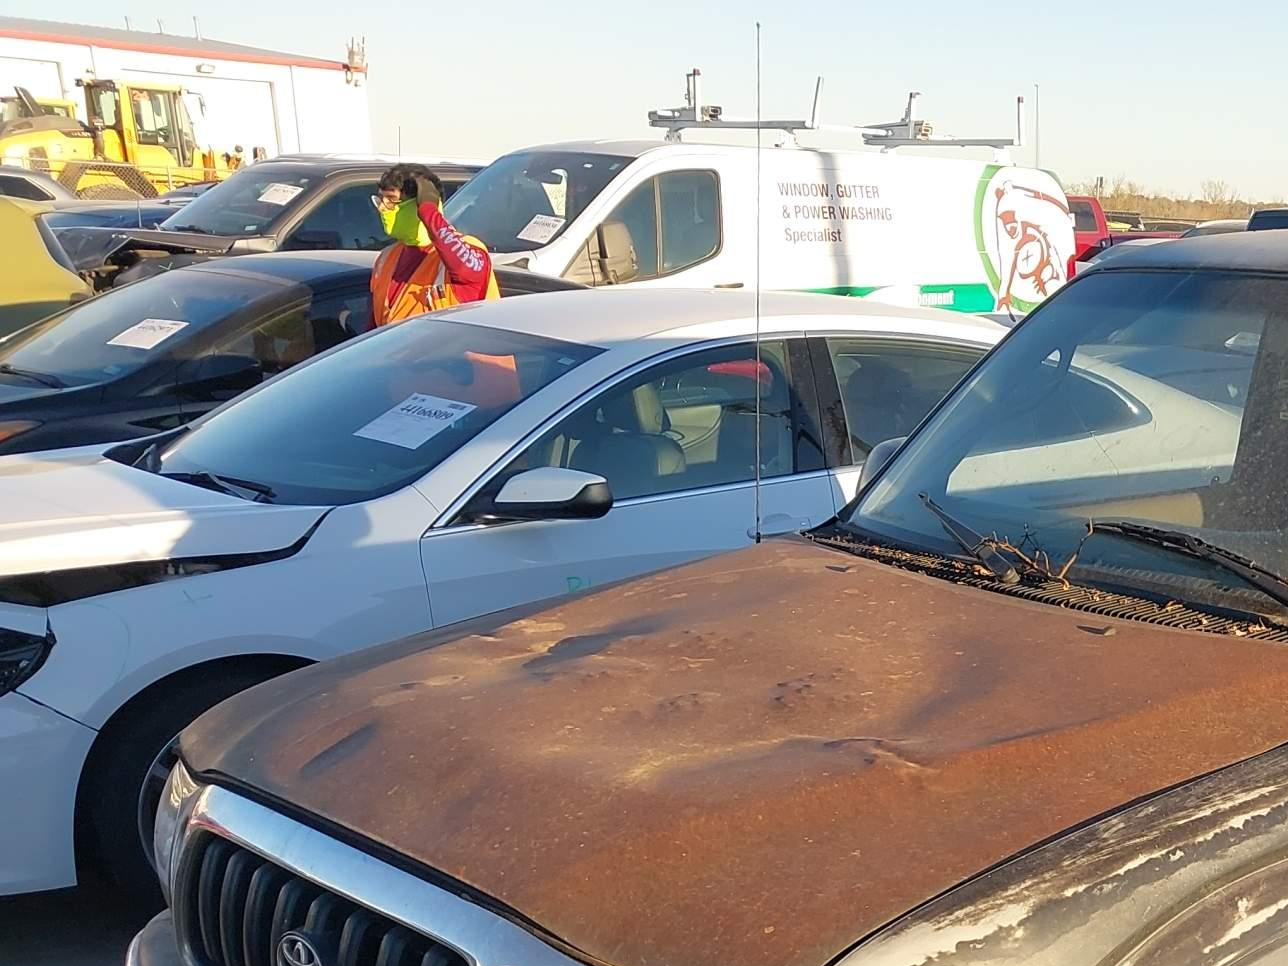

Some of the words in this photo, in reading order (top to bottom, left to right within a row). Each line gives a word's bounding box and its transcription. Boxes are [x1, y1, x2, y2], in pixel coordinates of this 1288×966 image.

[778, 183, 834, 200] WINDOW,
[836, 184, 880, 199] GUTTER
[782, 205, 791, 219] &
[795, 205, 836, 220] POWER
[839, 206, 893, 221] WASHING
[784, 228, 843, 244] Specialist
